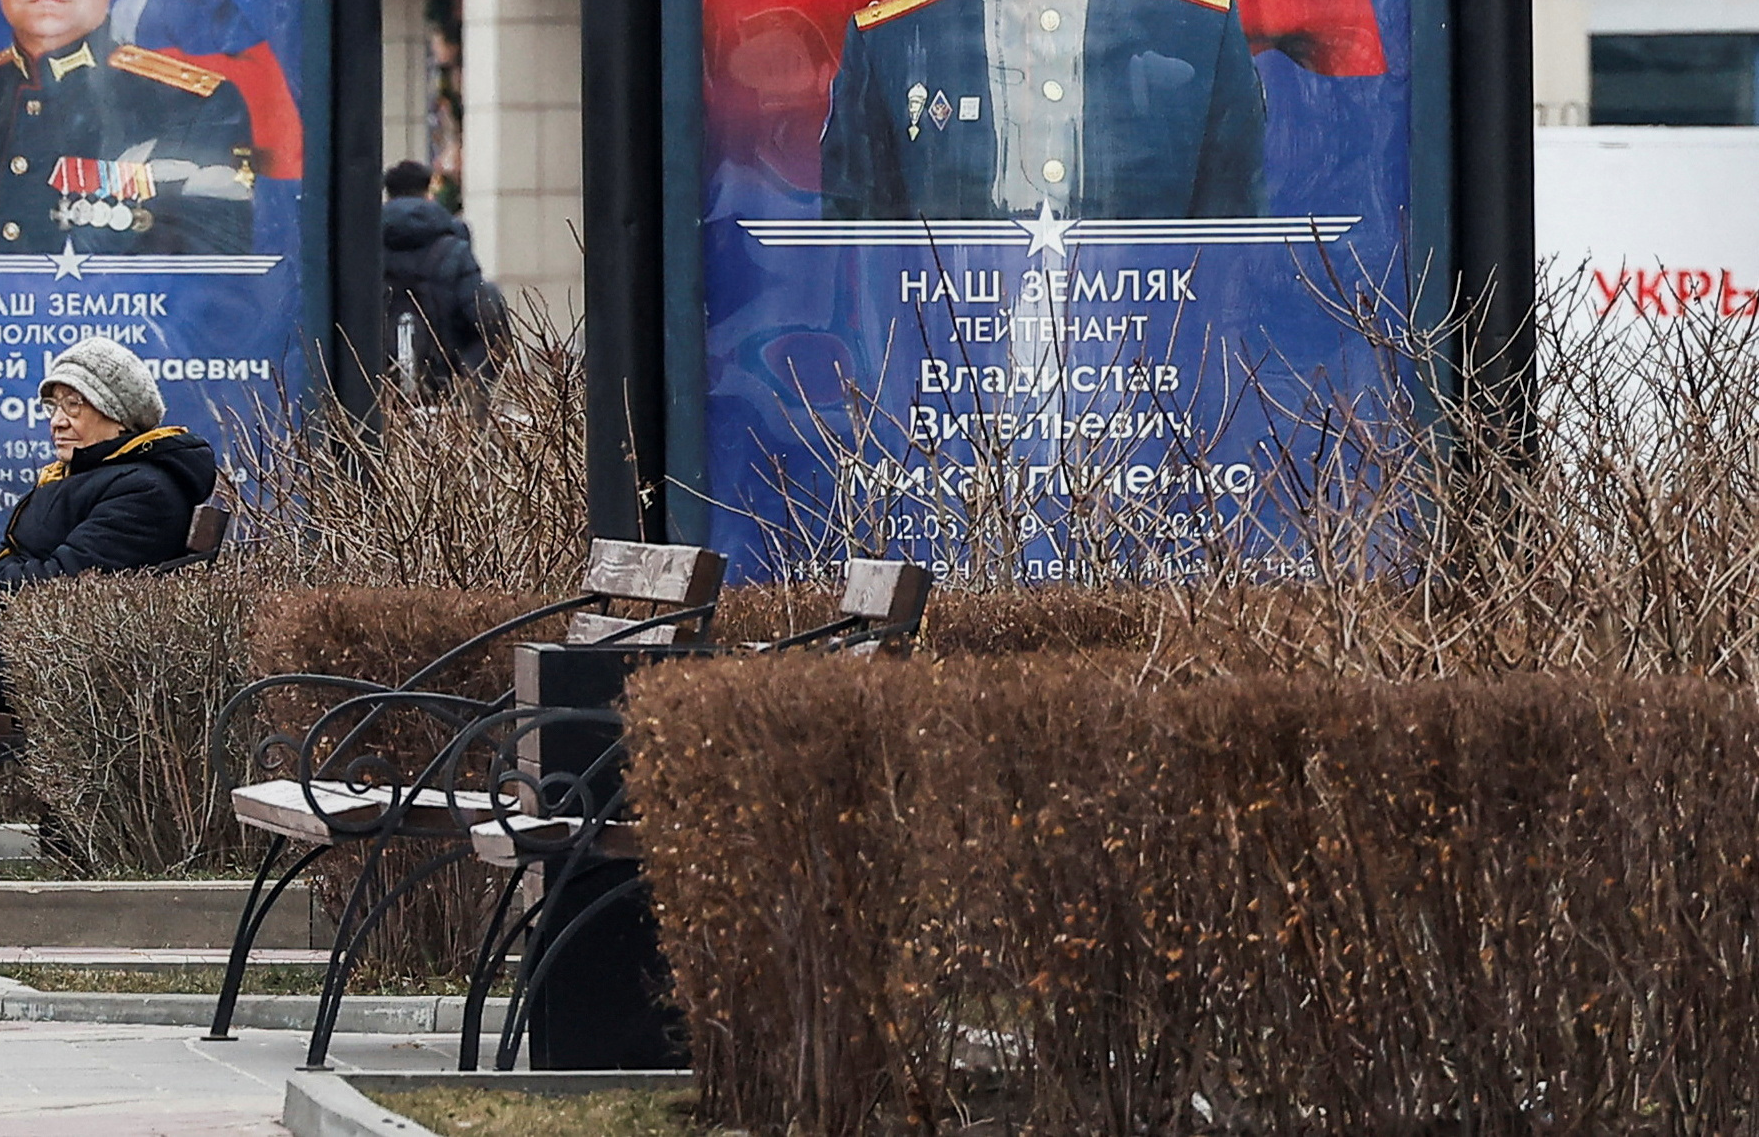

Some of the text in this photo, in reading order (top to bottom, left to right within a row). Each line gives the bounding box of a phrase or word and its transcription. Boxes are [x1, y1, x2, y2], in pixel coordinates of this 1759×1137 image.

[901, 268, 1197, 303] НАШ ЗЕМЛЯК
[48, 292, 168, 317] ЗЕМЛЯК
[949, 308, 1149, 343] ЛЕЙТЕНАНТ
[919, 358, 1181, 397] Владислав
[909, 404, 1193, 441] Витальевич
